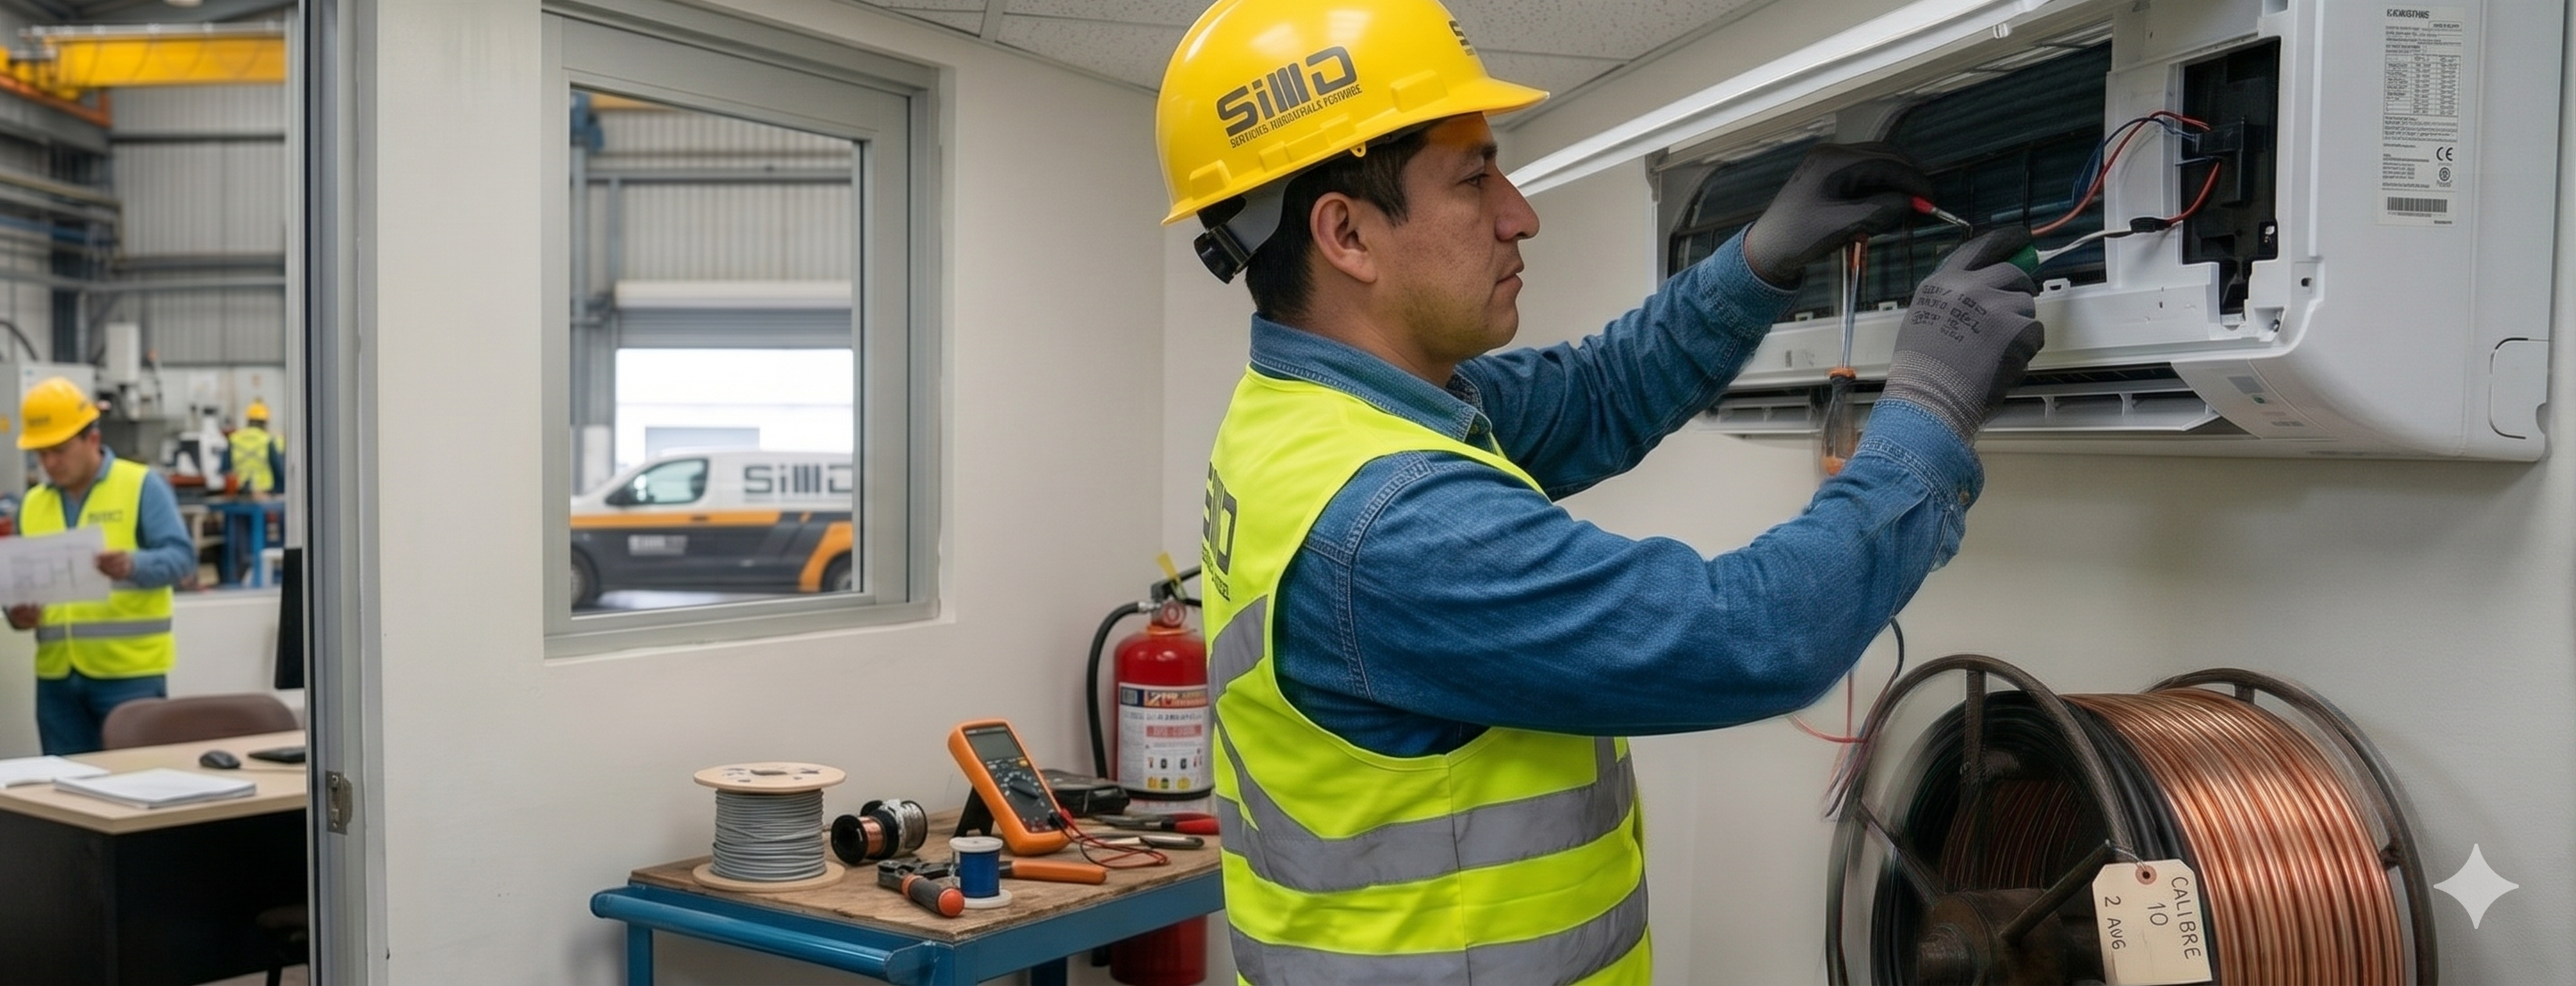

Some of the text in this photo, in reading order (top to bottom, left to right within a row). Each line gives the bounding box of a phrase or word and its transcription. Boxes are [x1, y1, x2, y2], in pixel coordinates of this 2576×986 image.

[2436, 146, 2453, 161] CE
[2105, 896, 2121, 907] 2
[2148, 903, 2168, 925] 10
[2171, 876, 2201, 959] CALIBRE
